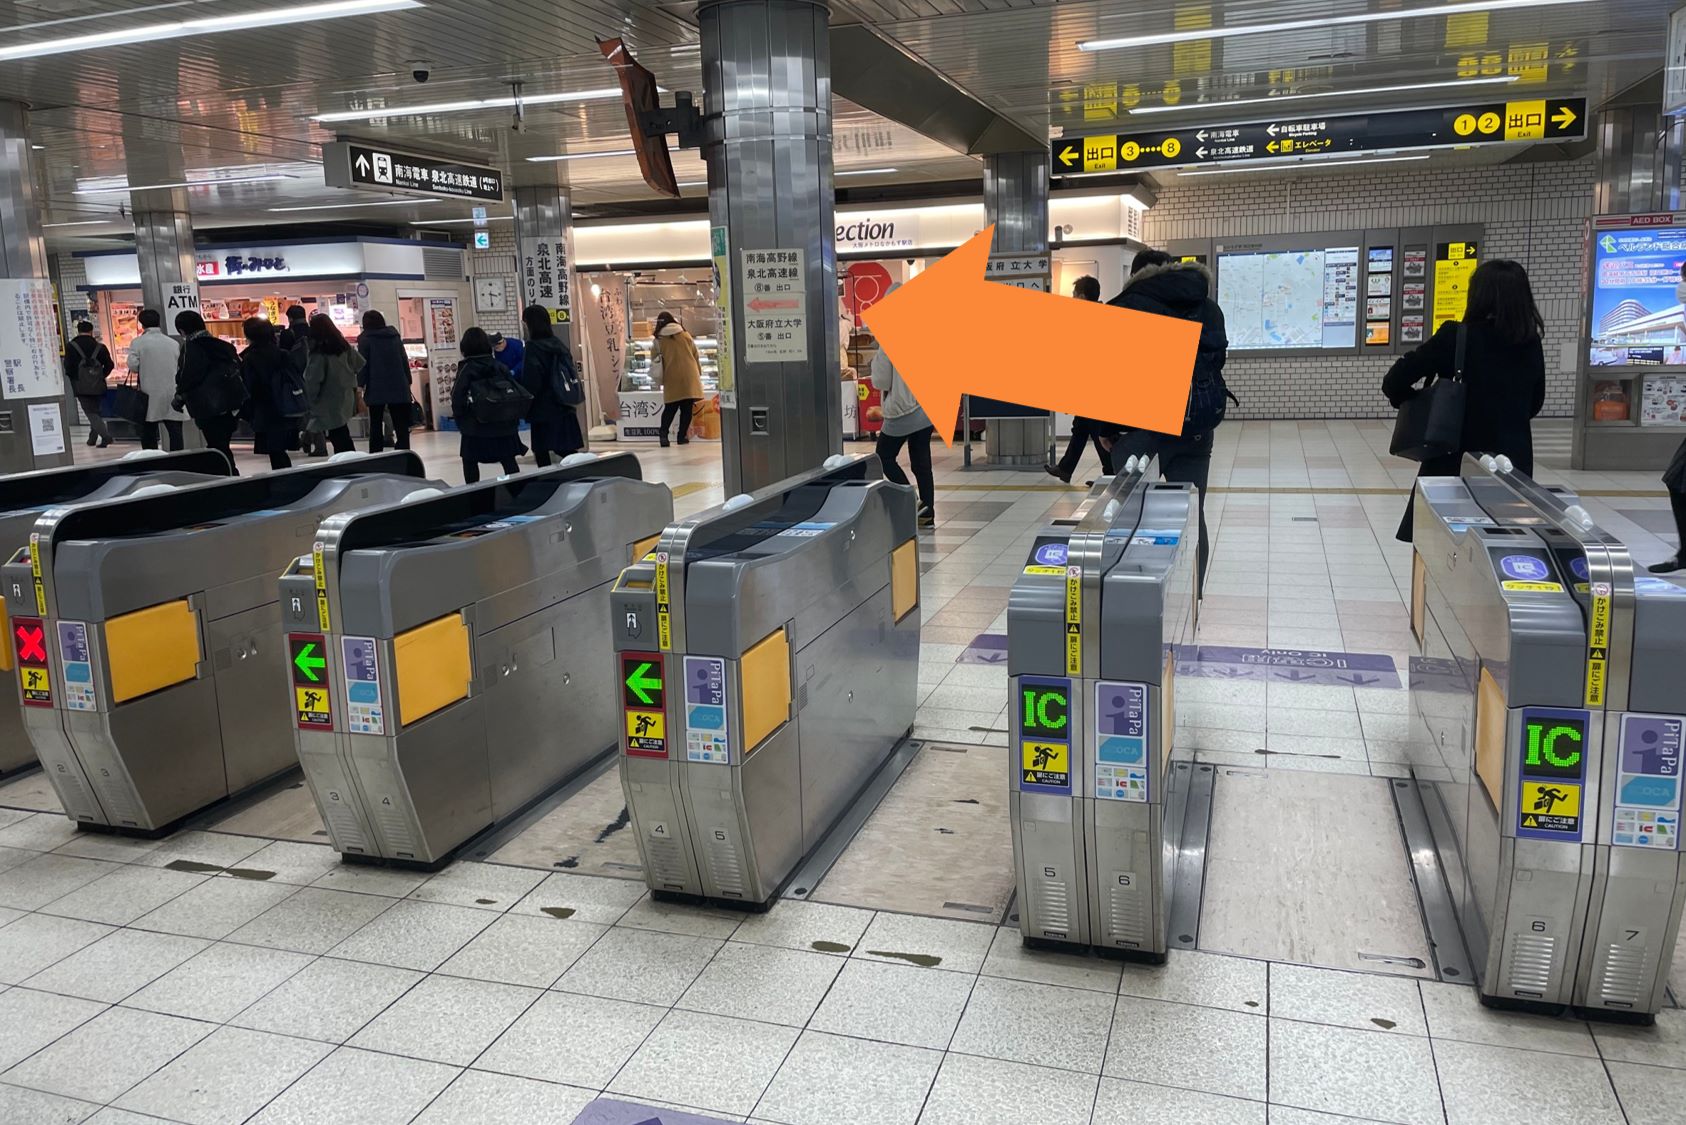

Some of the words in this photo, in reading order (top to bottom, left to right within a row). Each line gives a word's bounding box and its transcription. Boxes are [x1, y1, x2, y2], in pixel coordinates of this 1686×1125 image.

[1509, 113, 1541, 128] 出口
[1295, 138, 1332, 149] エレベータ
[1086, 146, 1113, 161] 出口
[394, 164, 429, 180] 南海電車
[431, 170, 478, 188] 泉北高速鉄道
[1633, 216, 1651, 224] AED
[1653, 215, 1671, 223] BOX
[746, 252, 798, 264] 南海高野線
[537, 242, 553, 298] 泉北高速
[555, 243, 569, 306] 南海高野線
[747, 268, 799, 279] 泉北高速線
[173, 285, 190, 294] 銀行
[168, 295, 198, 309] ATM
[747, 319, 802, 329] 大阪府立大学
[1070, 579, 1078, 620] かけこみ禁止
[1593, 597, 1606, 646] かけこみ禁止
[363, 641, 376, 680] PiTaPa
[709, 663, 722, 704] PiTaPa
[1589, 663, 1602, 702] 扉にご注意
[1023, 690, 1067, 730] IC
[1128, 688, 1142, 735] PiTaPa
[1526, 724, 1581, 767] IC
[1660, 722, 1680, 775] PiTaPa
[382, 796, 391, 806] 4
[1537, 815, 1574, 825] 扉にご注意
[655, 824, 664, 834] 4
[1044, 866, 1056, 878] 5
[1118, 875, 1130, 886] 6
[1532, 920, 1546, 932] 6
[1625, 930, 1640, 941] 7
